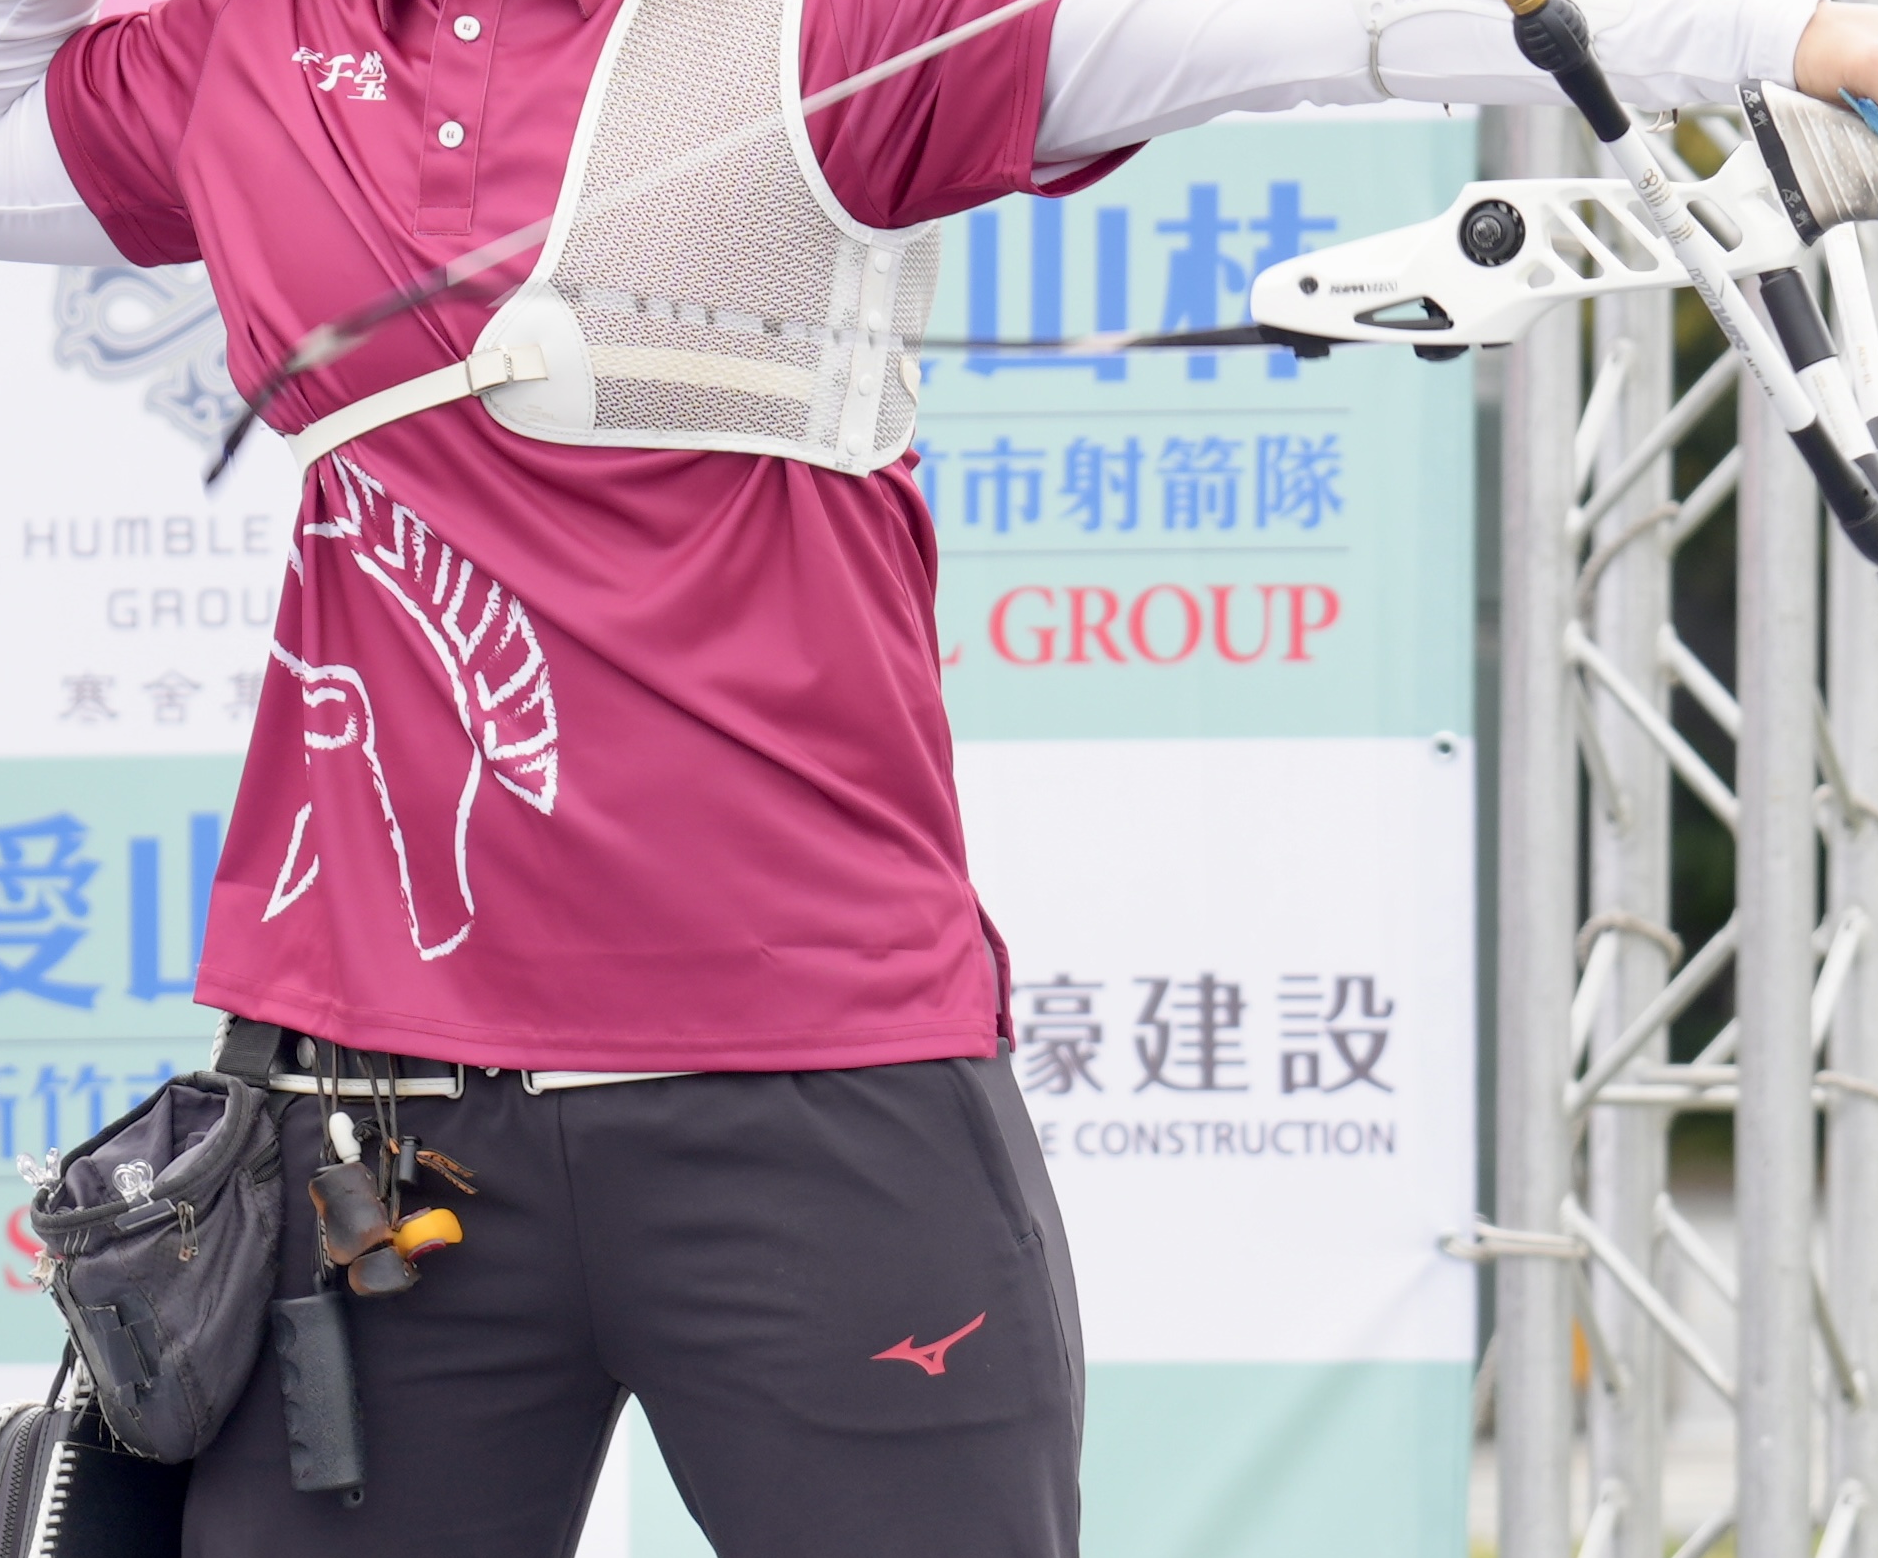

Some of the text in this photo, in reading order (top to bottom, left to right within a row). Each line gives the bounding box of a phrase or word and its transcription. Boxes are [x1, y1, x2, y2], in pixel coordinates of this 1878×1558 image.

[918, 180, 1338, 382] 山林
[916, 433, 1346, 535] 市射箭隊
[22, 513, 273, 560] HUMBLE
[106, 587, 275, 631] GROU
[989, 583, 1341, 666] GROUP
[1010, 973, 1395, 1095] 濠建設
[1074, 1121, 1397, 1157] CONSTRUCTION
